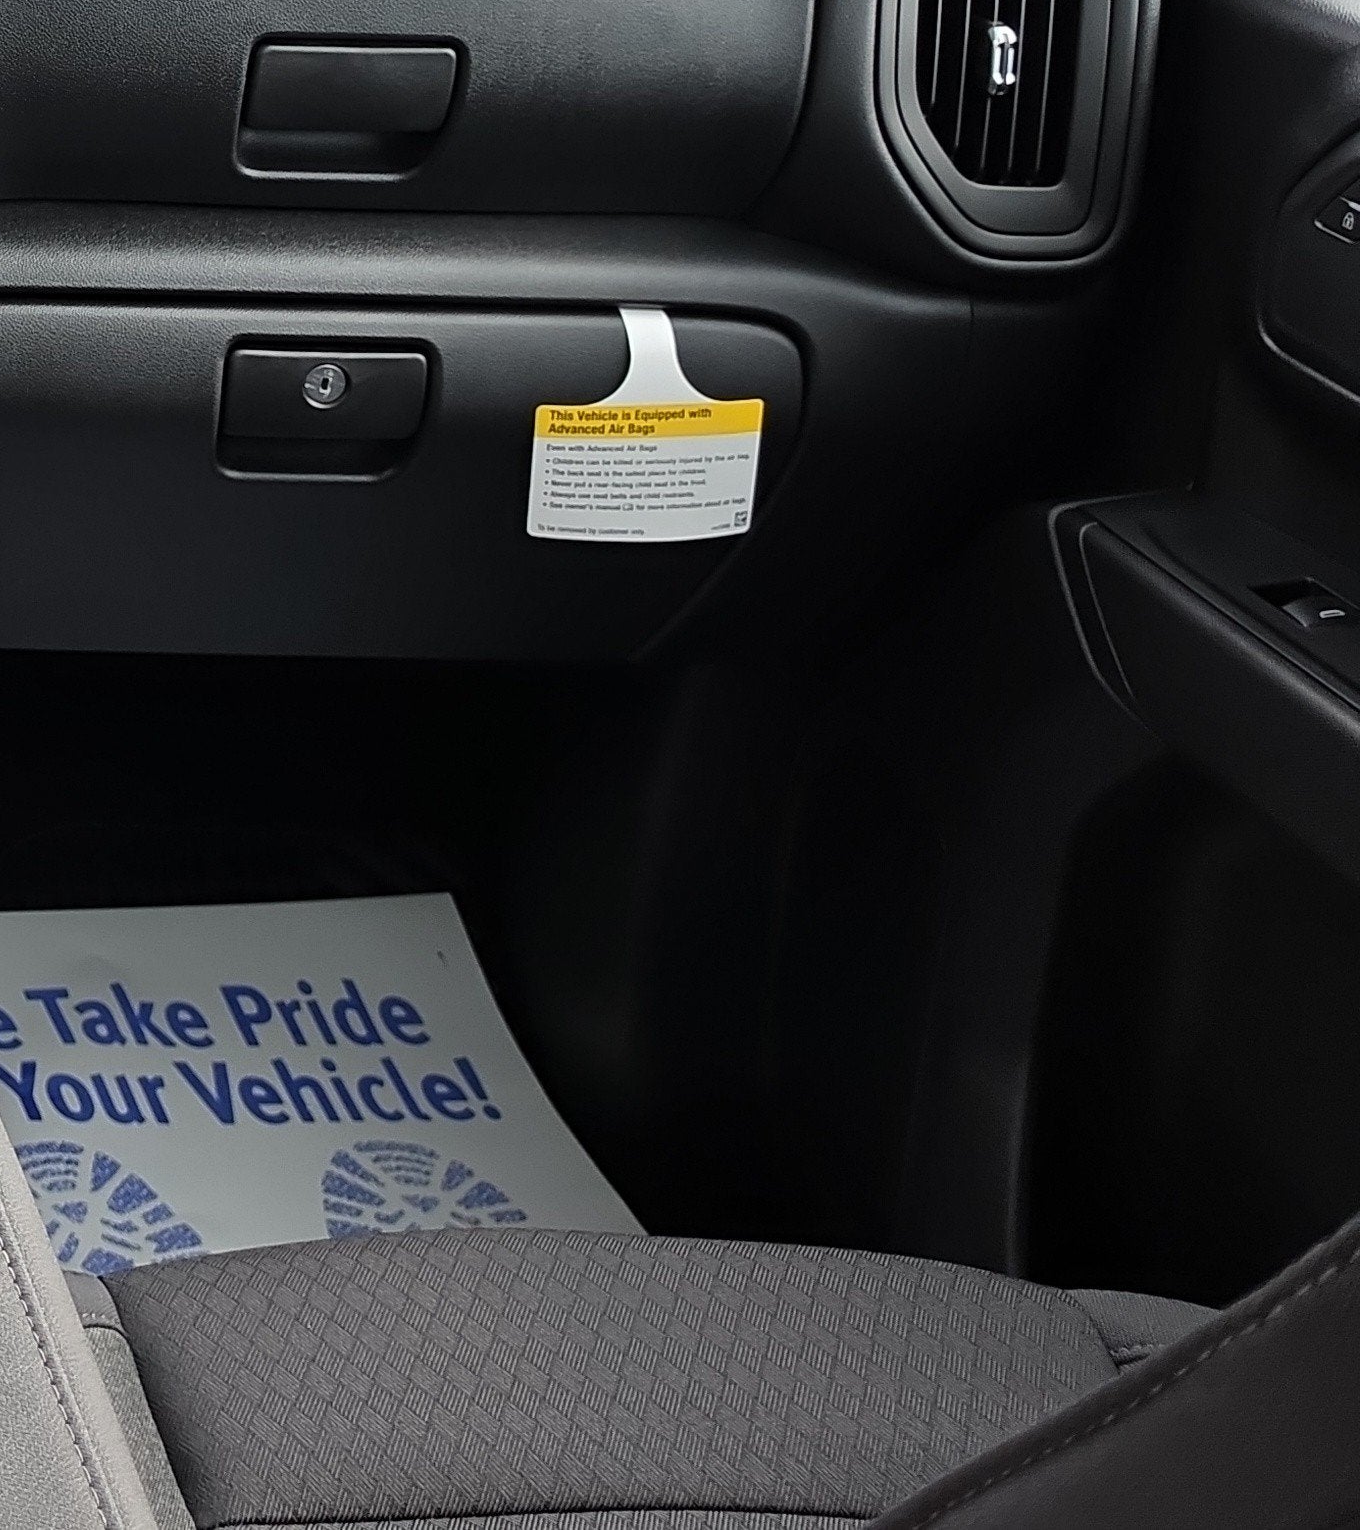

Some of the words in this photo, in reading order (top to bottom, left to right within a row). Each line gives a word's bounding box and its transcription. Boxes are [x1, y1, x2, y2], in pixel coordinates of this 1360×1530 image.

[547, 423, 606, 435] Advanced
[608, 423, 626, 434] Air
[627, 423, 656, 436] Bags
[550, 410, 574, 421] This
[576, 410, 619, 421] Vehicle
[621, 410, 632, 421] is
[634, 409, 685, 423] Equipped
[688, 408, 712, 419] with
[24, 981, 215, 1049] Take
[219, 978, 432, 1048] Pride
[172, 1056, 503, 1125] Vehicle!
